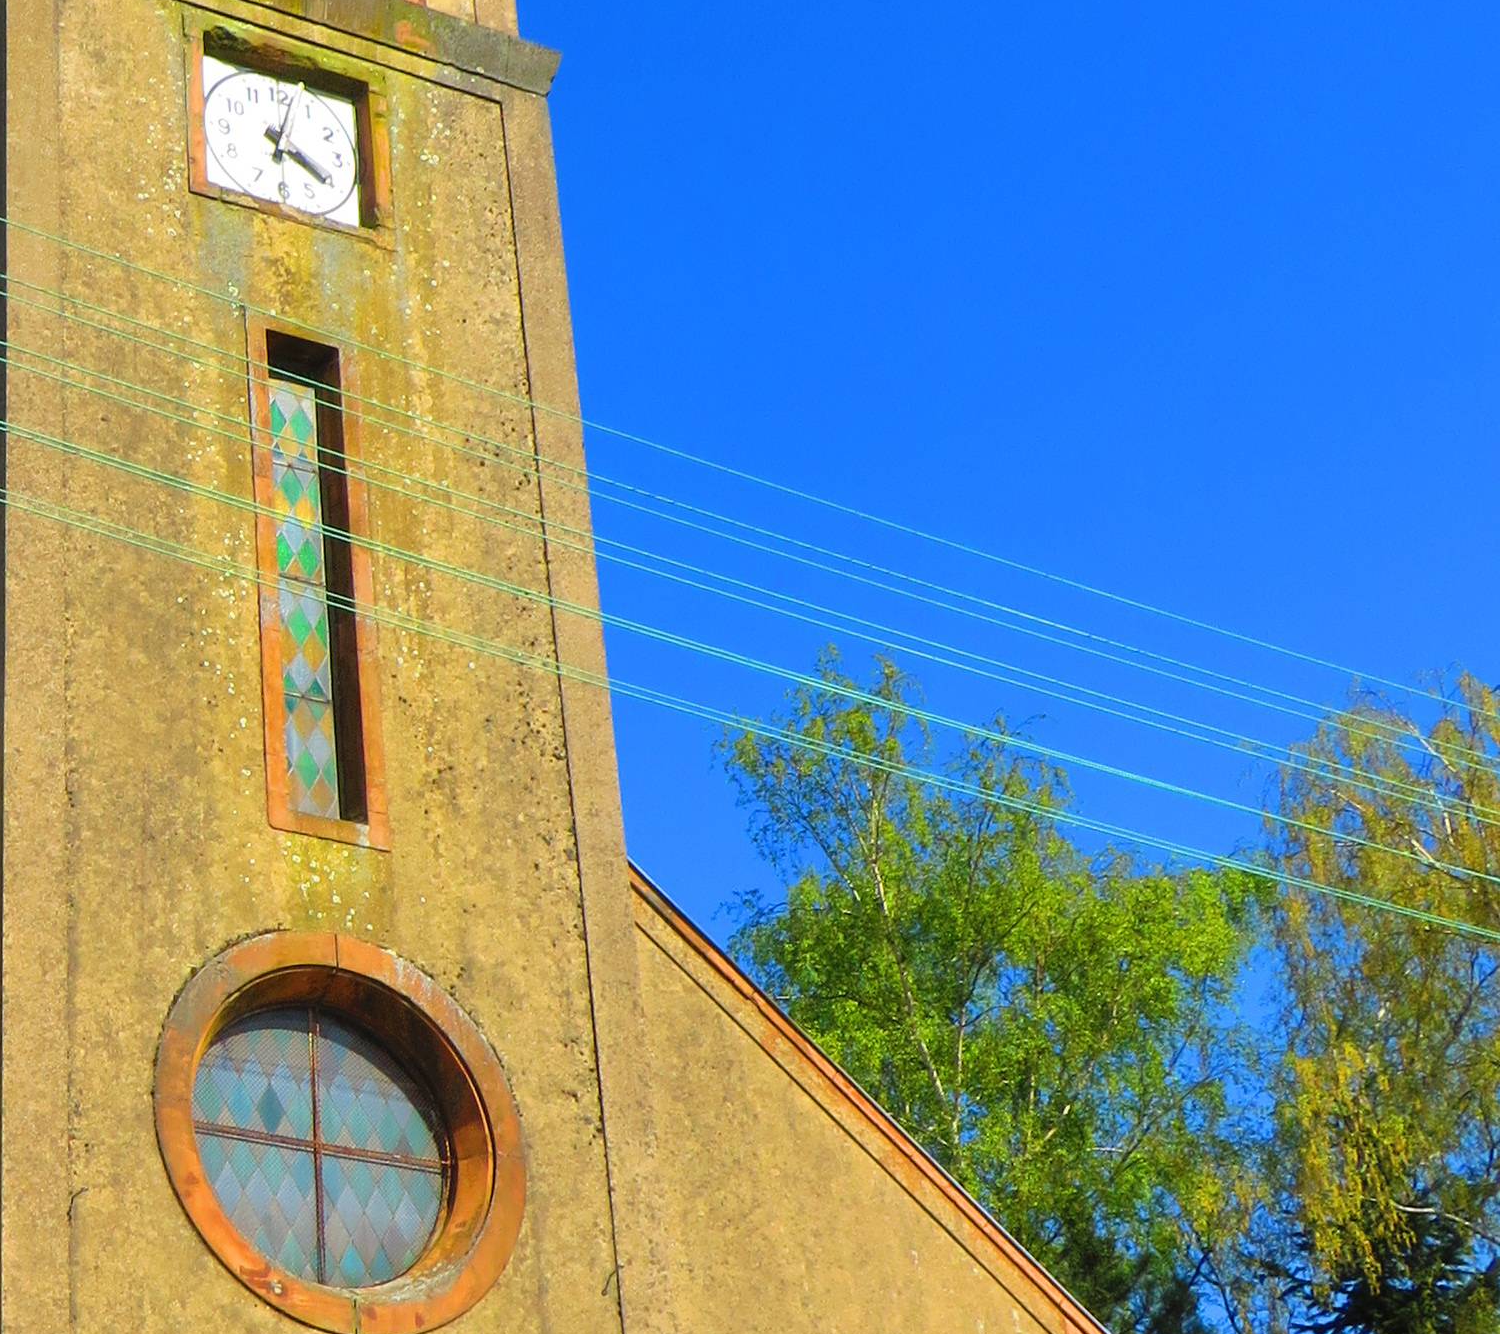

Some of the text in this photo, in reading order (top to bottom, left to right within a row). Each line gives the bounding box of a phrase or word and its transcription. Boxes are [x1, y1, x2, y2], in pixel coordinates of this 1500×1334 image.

[246, 87, 258, 104] 11
[269, 87, 290, 107] 12
[227, 97, 245, 116] 10
[305, 104, 311, 120] 1
[218, 118, 231, 135] 9
[322, 127, 334, 144] 2
[226, 142, 238, 159] 8
[331, 151, 343, 168] 3
[252, 166, 264, 182] 7
[277, 181, 291, 200] 6
[303, 182, 316, 200] 5
